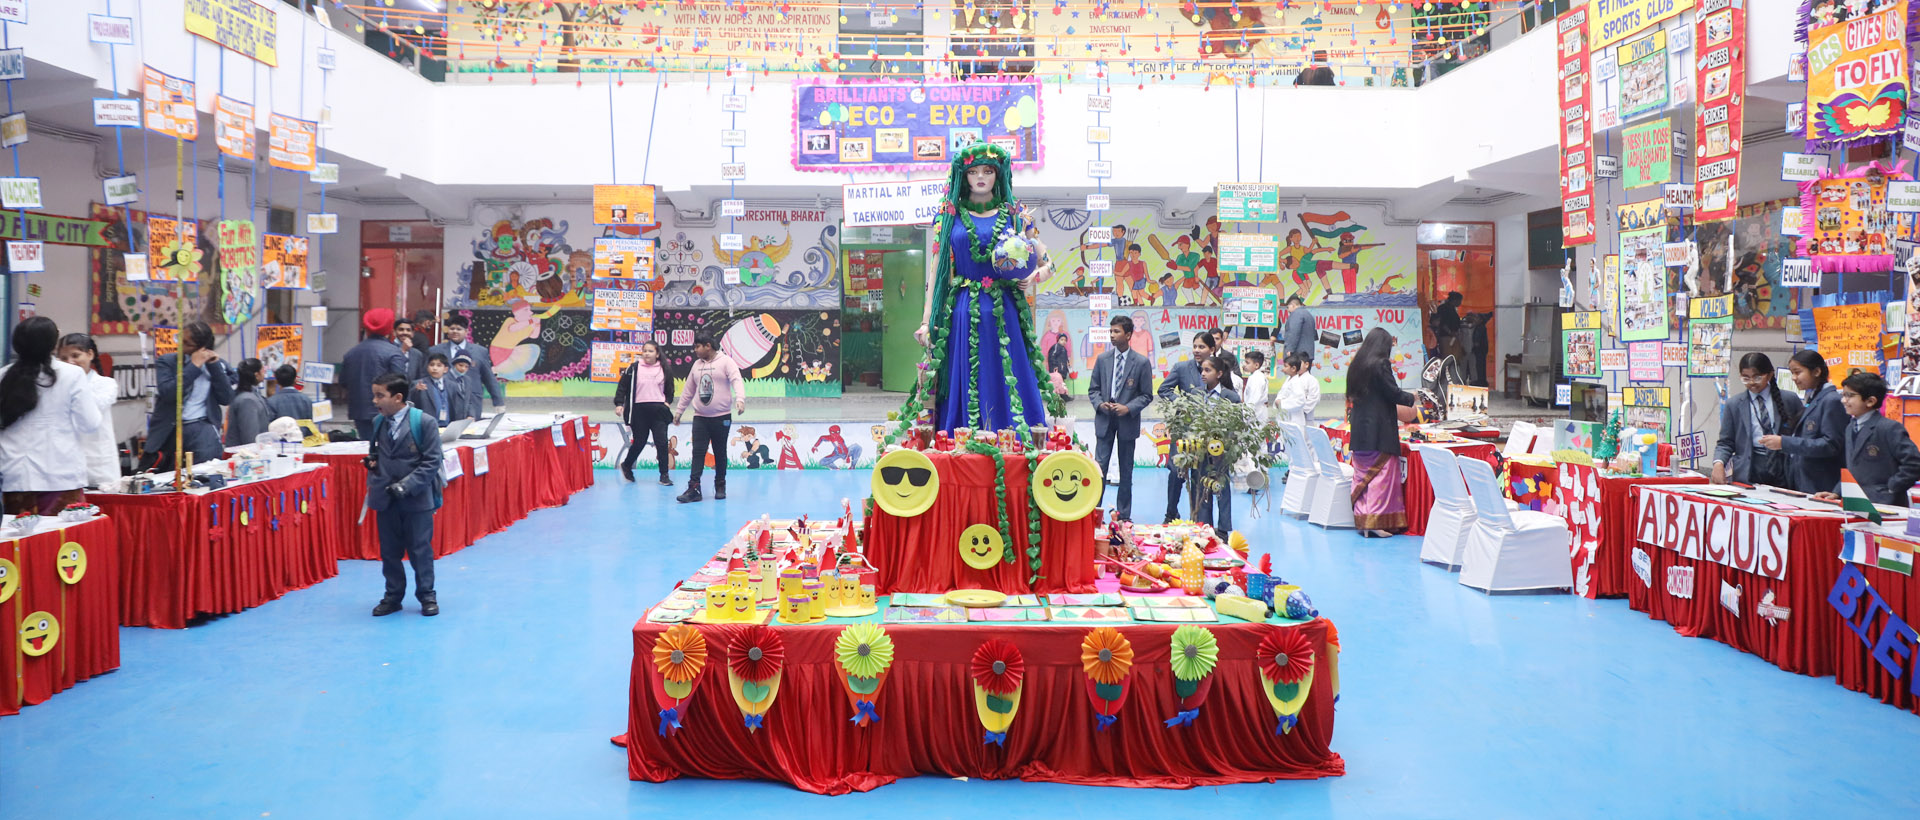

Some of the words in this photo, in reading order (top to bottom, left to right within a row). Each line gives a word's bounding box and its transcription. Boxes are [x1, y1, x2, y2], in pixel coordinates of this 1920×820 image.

[674, 14, 694, 24] WITH
[698, 14, 721, 25] NEW
[724, 14, 752, 24] HOPES
[757, 14, 775, 24] AND
[1603, 8, 1641, 40] SPORTS
[1647, 0, 1674, 20] CLUB
[1089, 25, 1131, 34] INVESTMENT
[1847, 15, 1881, 50] GIVES
[1886, 10, 1897, 39] US
[1631, 36, 1655, 60] SKATING
[1808, 35, 1841, 75] BCS
[1709, 49, 1728, 67] CHESS
[1837, 61, 1867, 88] TO
[1871, 52, 1899, 83] FLY
[929, 86, 1003, 102] CONVENT
[102, 103, 135, 113] ARTIFICIAL
[1088, 98, 1110, 110] DISCIPLINE
[848, 105, 895, 126] ECO
[929, 105, 991, 126] EXPO
[1704, 107, 1726, 124] CRICKET
[1601, 159, 1615, 167] TEAM
[1699, 160, 1735, 179] BASKETBALL
[1598, 168, 1617, 177] EFFORT
[1784, 167, 1820, 176] RELIABILI
[2, 181, 40, 205] VACCINE
[847, 186, 892, 200] MARTIAL
[896, 186, 911, 197] ART
[1666, 188, 1696, 205] HEALTHY
[791, 211, 826, 222] BHARAT
[853, 209, 905, 223] TAEKWONDO
[12, 215, 47, 241] FLM
[56, 221, 90, 244] CITY
[1089, 230, 1111, 240] FOCUS
[264, 235, 282, 251] LINE
[220, 246, 256, 269] ROBOTICS
[1090, 263, 1111, 274] RESPECT
[595, 291, 620, 299] TAEKWONDO
[622, 291, 646, 300] EXERCISES
[606, 299, 615, 307] AND
[615, 300, 638, 308] ACTIVITIES
[1160, 308, 1170, 324] A
[1179, 314, 1219, 329] WARM
[1315, 315, 1364, 331] WAITS
[1375, 309, 1405, 325] YOU
[257, 325, 293, 340] WIRELESS
[654, 331, 666, 344] TO
[672, 331, 695, 344] ASSAM
[1601, 352, 1627, 366] ENERGETIC
[1663, 346, 1688, 361] ENERGE
[1637, 492, 1784, 580] ABACUS
